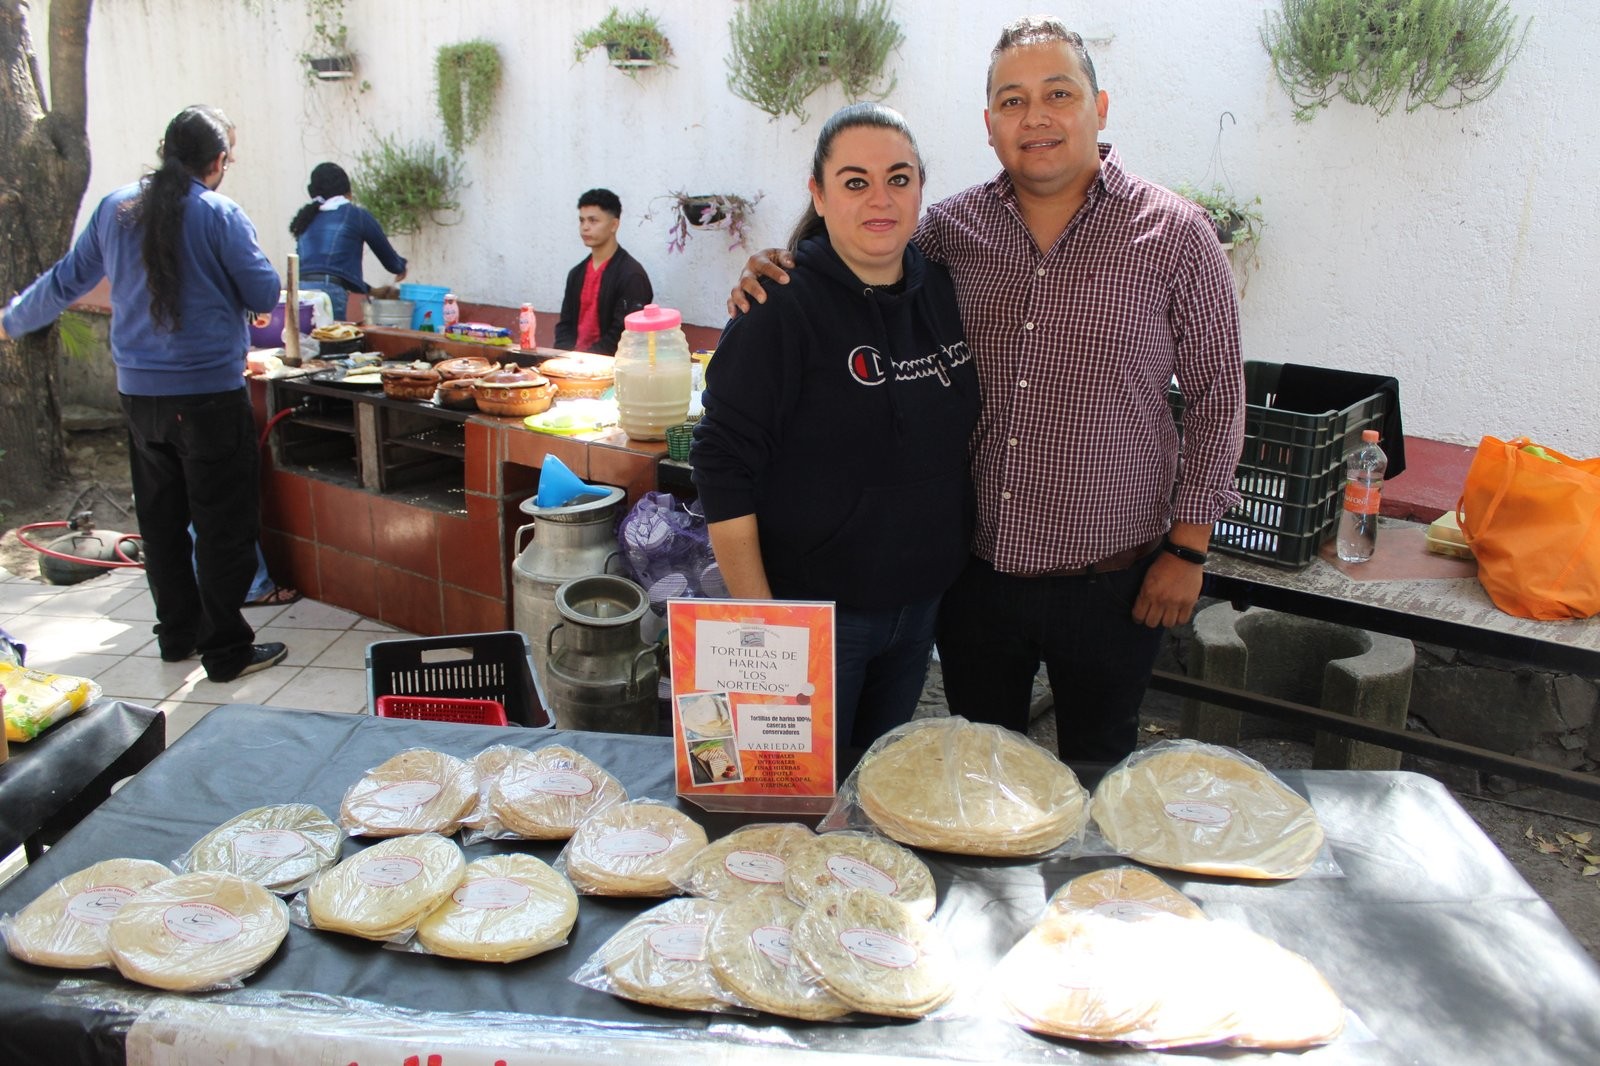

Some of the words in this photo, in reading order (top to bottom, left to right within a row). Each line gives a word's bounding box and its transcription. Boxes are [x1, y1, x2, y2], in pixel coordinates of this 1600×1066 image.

[711, 646, 777, 659] TORTILLAS
[782, 651, 798, 660] DE
[729, 658, 778, 670] HARINA
[738, 669, 767, 680] "LOS
[716, 680, 790, 693] NORTEÑOS"
